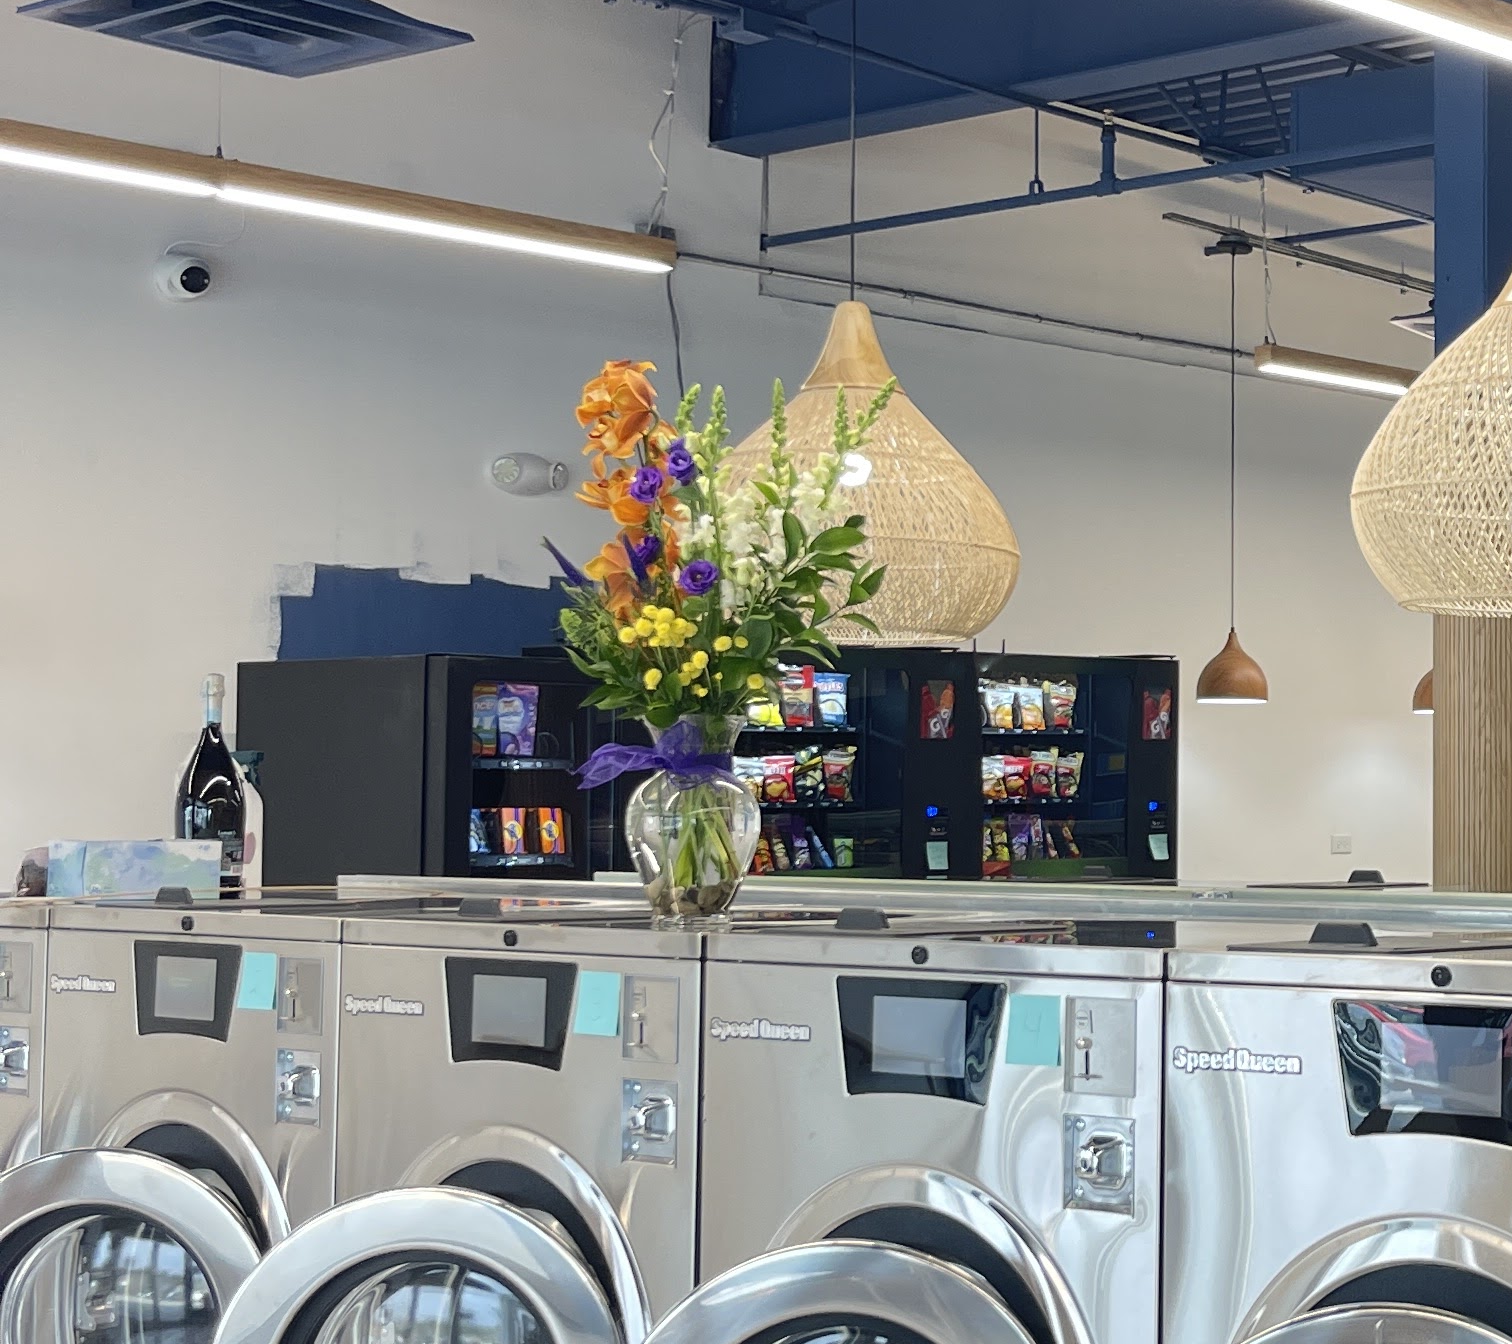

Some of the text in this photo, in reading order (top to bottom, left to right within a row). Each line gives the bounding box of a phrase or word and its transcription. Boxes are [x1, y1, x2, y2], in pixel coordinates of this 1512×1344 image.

[50, 974, 116, 994] Speed Queen
[345, 994, 423, 1016] Speed Queen
[711, 1017, 811, 1041] Speed Queen
[1173, 1046, 1302, 1074] Speed Queen
